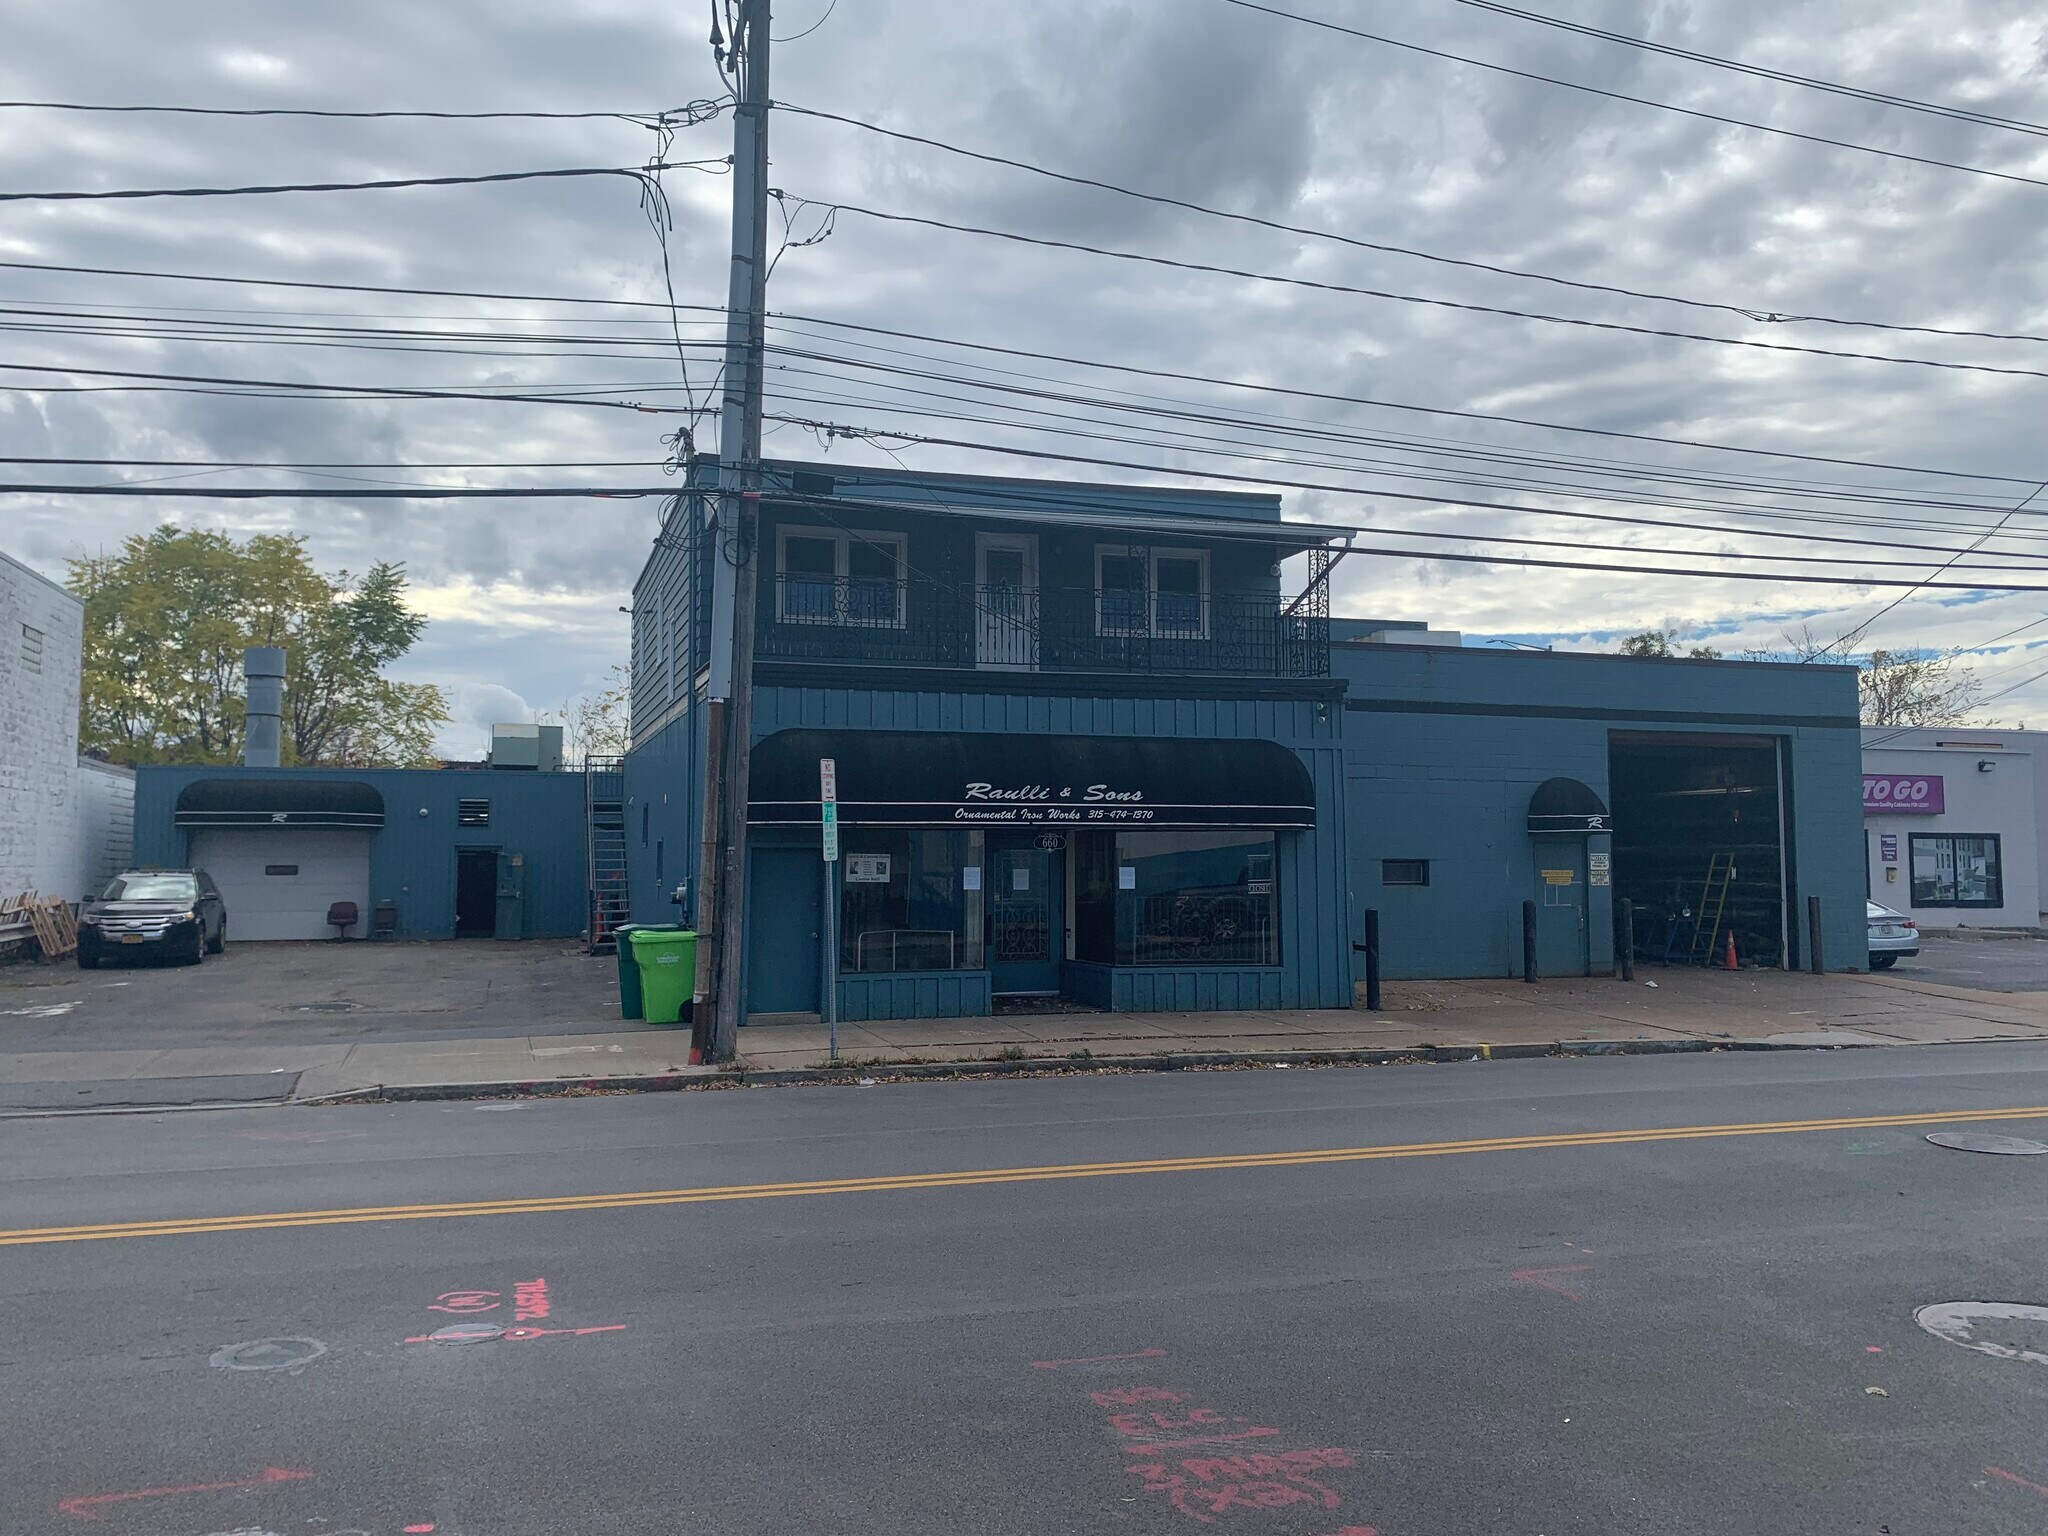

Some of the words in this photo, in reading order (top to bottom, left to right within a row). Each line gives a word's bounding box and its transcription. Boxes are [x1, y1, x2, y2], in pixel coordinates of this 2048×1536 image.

[965, 782, 1050, 800] Raulli
[1059, 787, 1071, 797] &
[1083, 784, 1144, 801] Sons
[1862, 780, 1891, 800] TO
[1893, 780, 1928, 800] GO
[954, 808, 1017, 819] Ornamental
[1020, 808, 1043, 820] Iron
[1048, 809, 1081, 820] Works
[1088, 810, 1154, 819] 315-474-1370
[1587, 816, 1603, 829] R
[1042, 837, 1058, 848] 660
